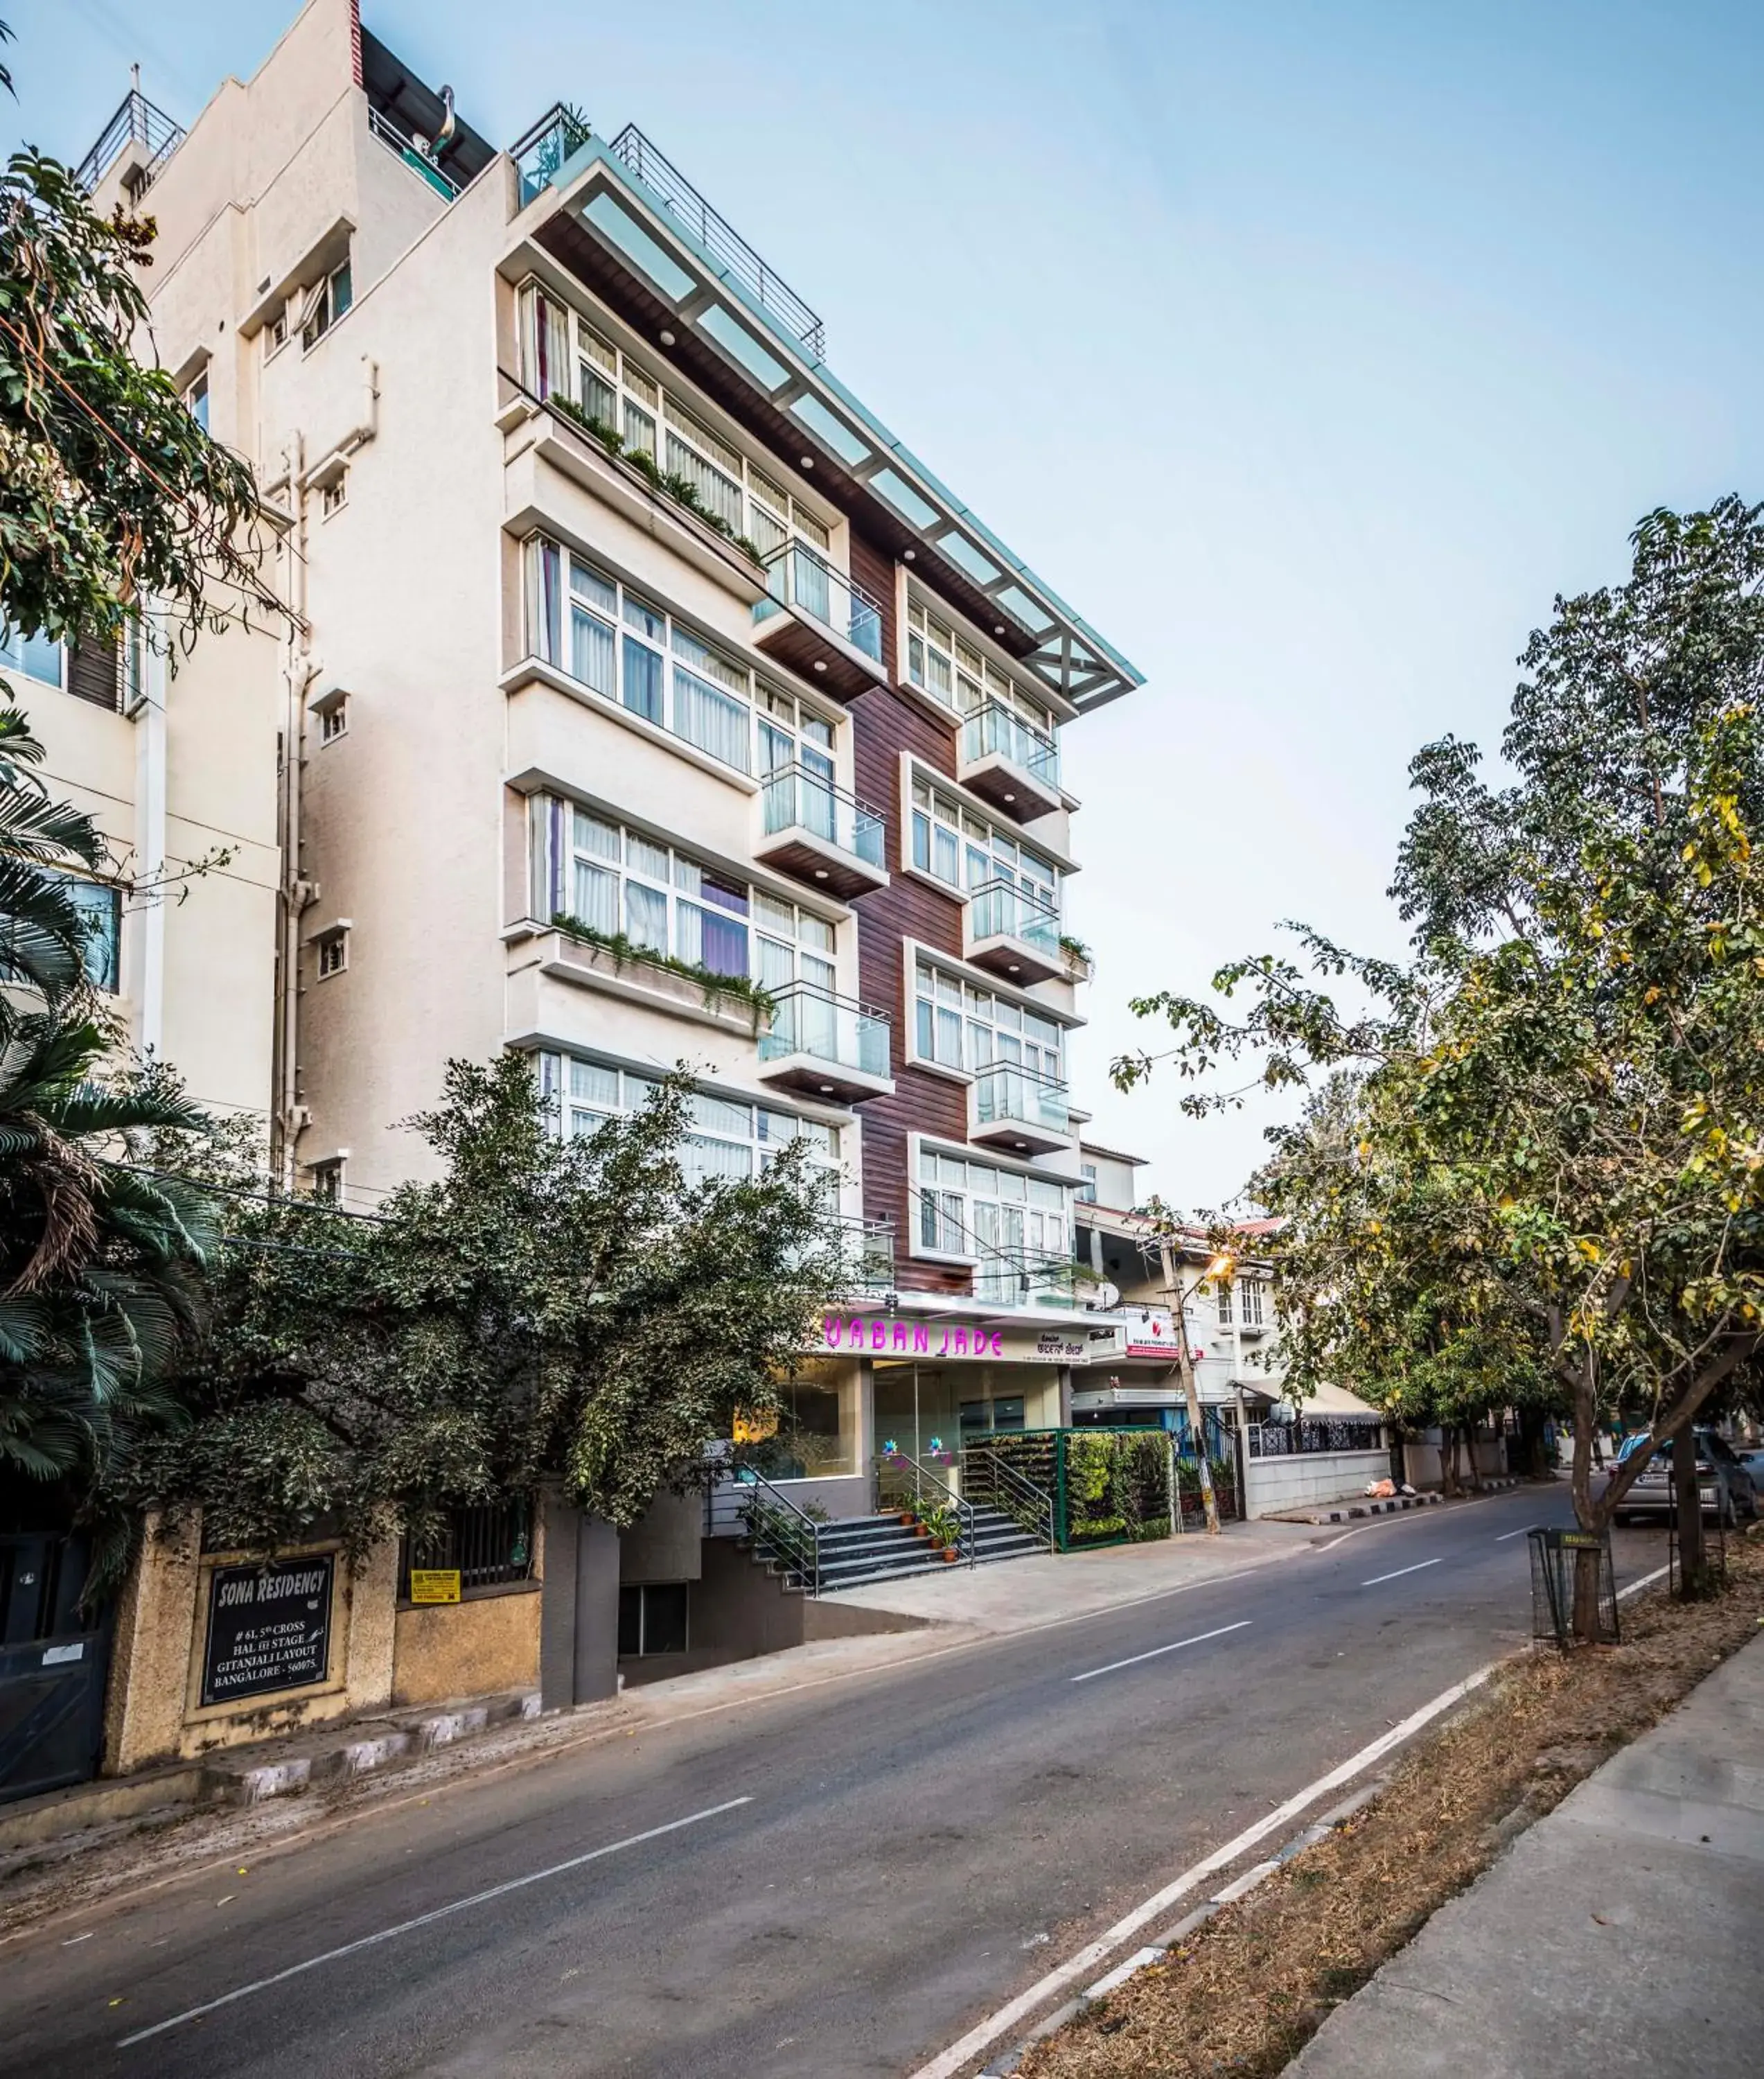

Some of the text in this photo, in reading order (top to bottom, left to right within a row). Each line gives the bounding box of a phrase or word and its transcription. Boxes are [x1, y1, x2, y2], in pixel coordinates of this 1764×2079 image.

[825, 1315, 1003, 1356] URBAN JADE
[218, 1570, 326, 1608] SONA RESIDENCY
[272, 1621, 306, 1635] CROSS
[233, 1643, 256, 1656] HAL
[271, 1634, 305, 1648] STAGE
[217, 1644, 317, 1673] GITANJALI LAYOUT
[213, 1665, 281, 1687] BANGALORE
